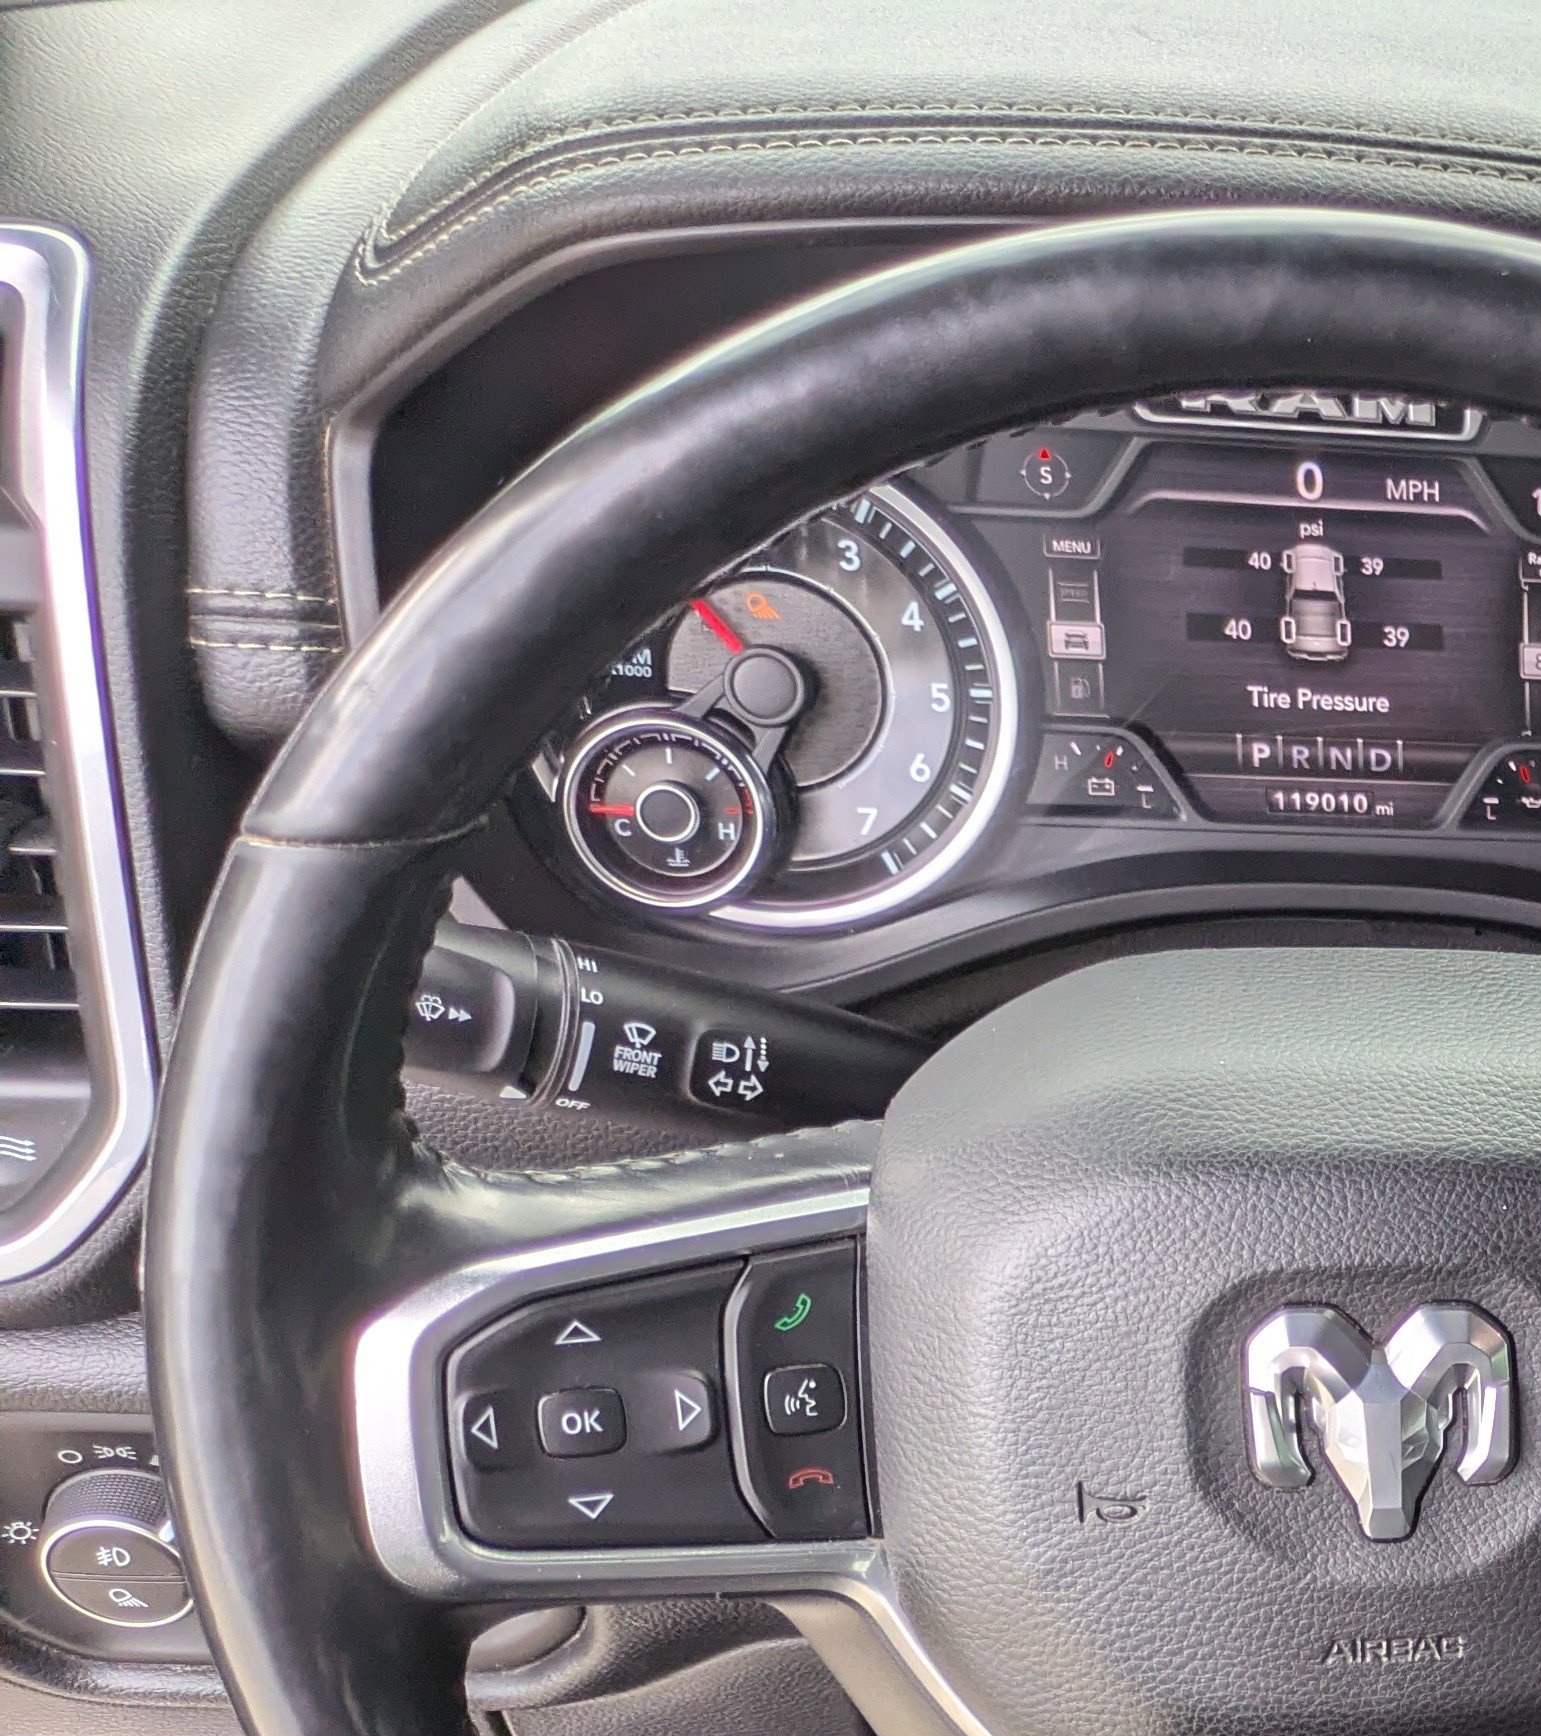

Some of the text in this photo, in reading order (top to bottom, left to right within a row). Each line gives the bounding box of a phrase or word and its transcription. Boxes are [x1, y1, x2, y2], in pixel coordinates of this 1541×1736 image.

[1040, 466, 1053, 485] S
[1297, 462, 1440, 502] 0 MPH
[1300, 519, 1324, 539] psi
[838, 540, 861, 570] 3
[1052, 540, 1091, 555] MENU
[1248, 552, 1272, 571] 40
[1361, 558, 1384, 576] 39
[901, 601, 923, 632] 4
[1224, 619, 1252, 641] 40
[1383, 626, 1410, 648] 39
[930, 683, 951, 713] 5
[1247, 685, 1390, 713] Tire Pressure
[910, 754, 931, 782] 6
[1055, 755, 1068, 772] H
[1252, 743, 1392, 773] P R N D
[1273, 791, 1395, 817] 119010 mi
[614, 818, 632, 838] C
[718, 821, 736, 841] H
[857, 807, 878, 835] 7
[578, 957, 598, 974] HI
[581, 987, 604, 1005] LO
[614, 1045, 662, 1065] FRONT
[613, 1059, 658, 1079] WIPER
[555, 1097, 591, 1111] OFF
[561, 1409, 604, 1436] OK
[1322, 1635, 1467, 1665] AIRBAG
